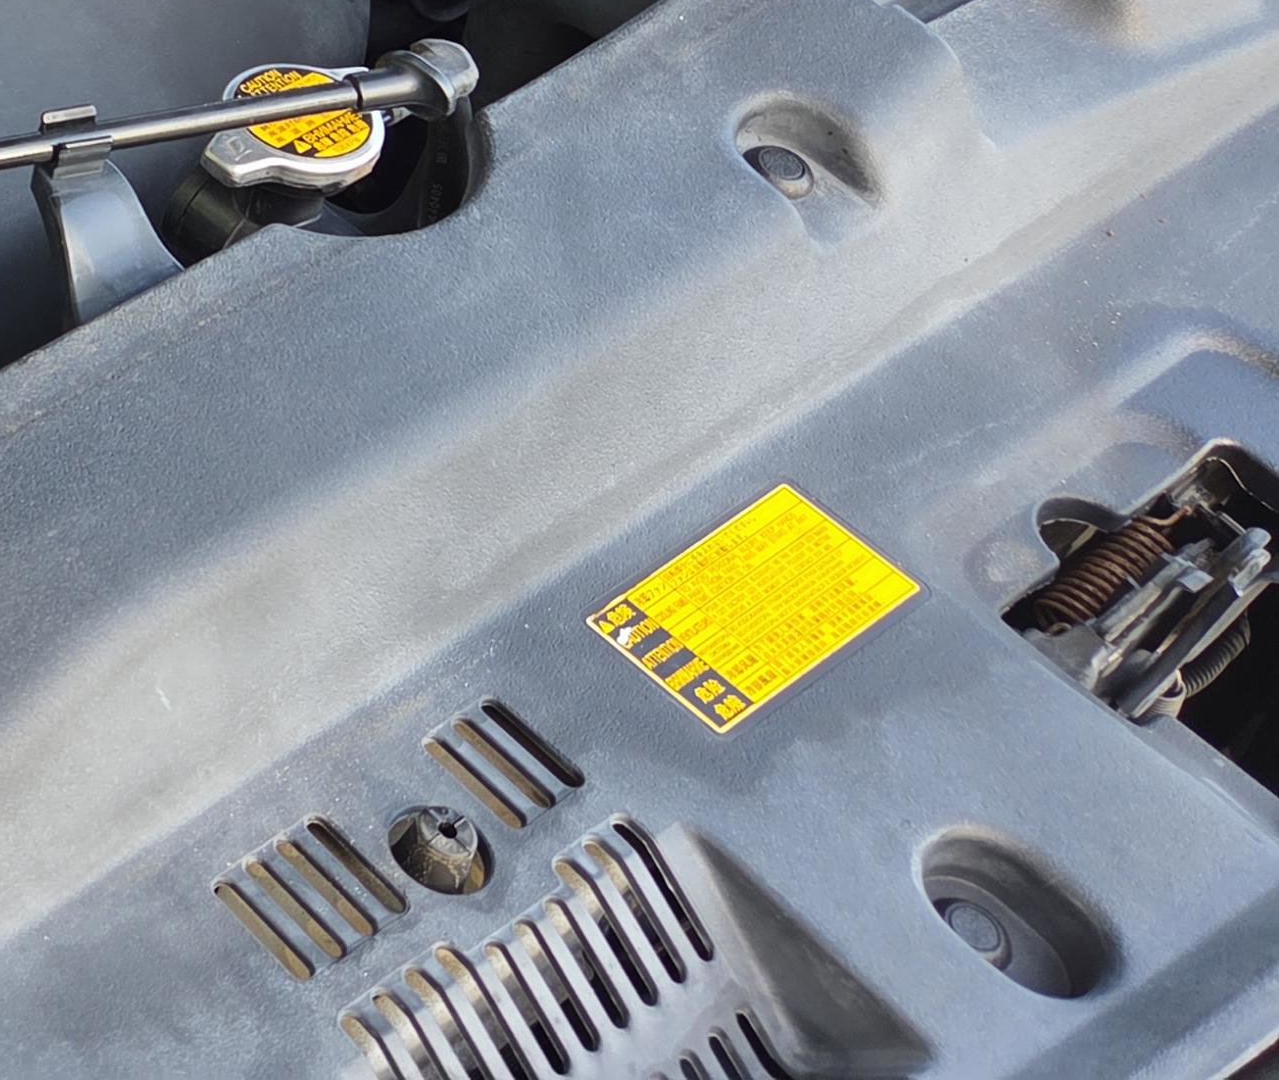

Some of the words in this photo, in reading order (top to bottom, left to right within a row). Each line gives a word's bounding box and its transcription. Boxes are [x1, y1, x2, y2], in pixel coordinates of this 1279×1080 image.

[240, 68, 282, 94] CAUTION
[244, 70, 303, 98] TTENTION
[638, 635, 685, 670] ATTENTION
